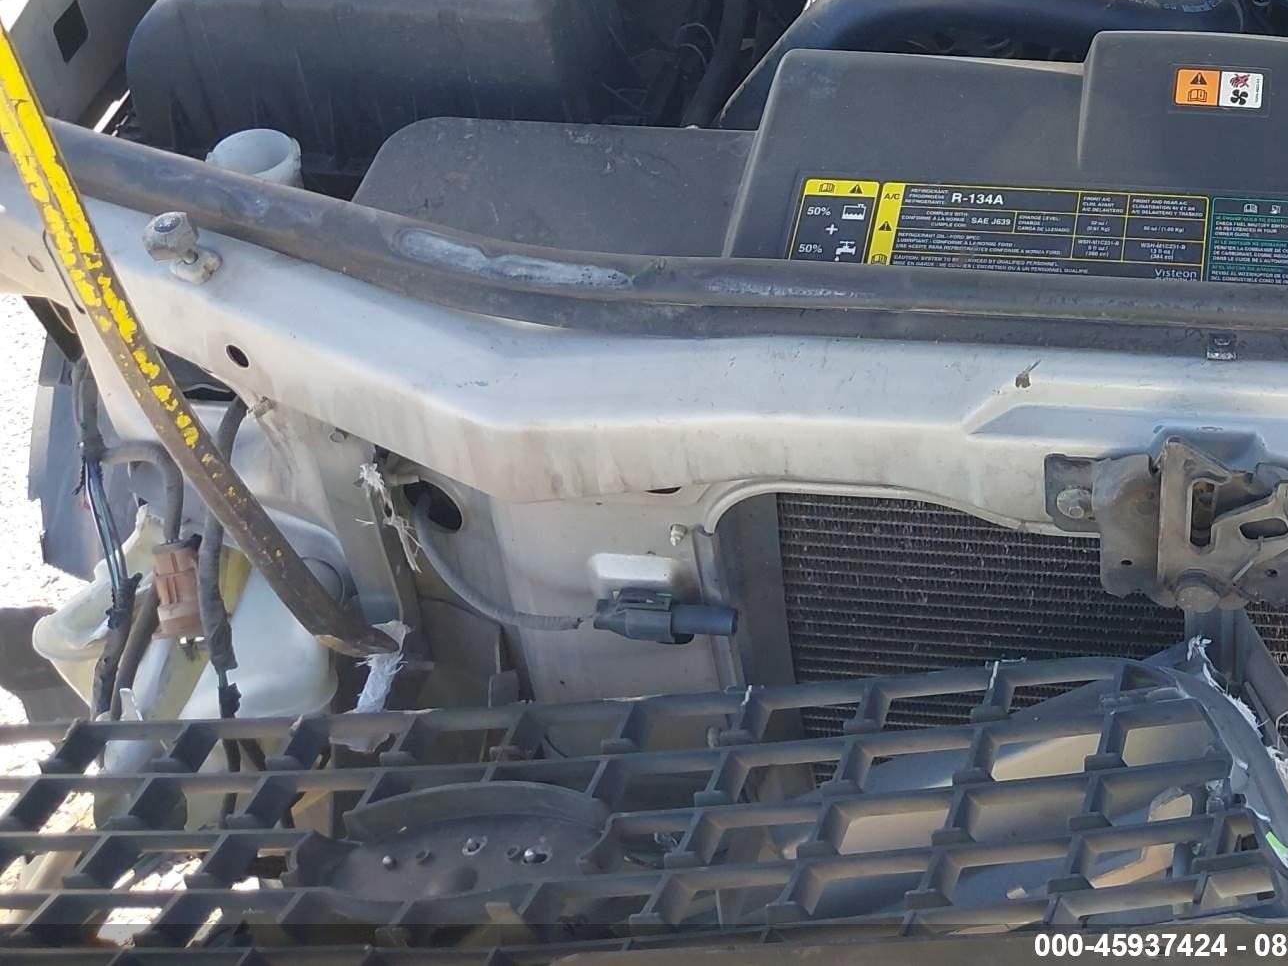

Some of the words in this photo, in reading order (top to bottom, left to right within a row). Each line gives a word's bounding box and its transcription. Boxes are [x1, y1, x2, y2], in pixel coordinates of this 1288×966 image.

[951, 193, 1003, 205] R-134A
[806, 206, 832, 216] 50%
[991, 218, 1011, 226] J639
[798, 242, 823, 254] 50%
[1155, 269, 1196, 277] Visteon
